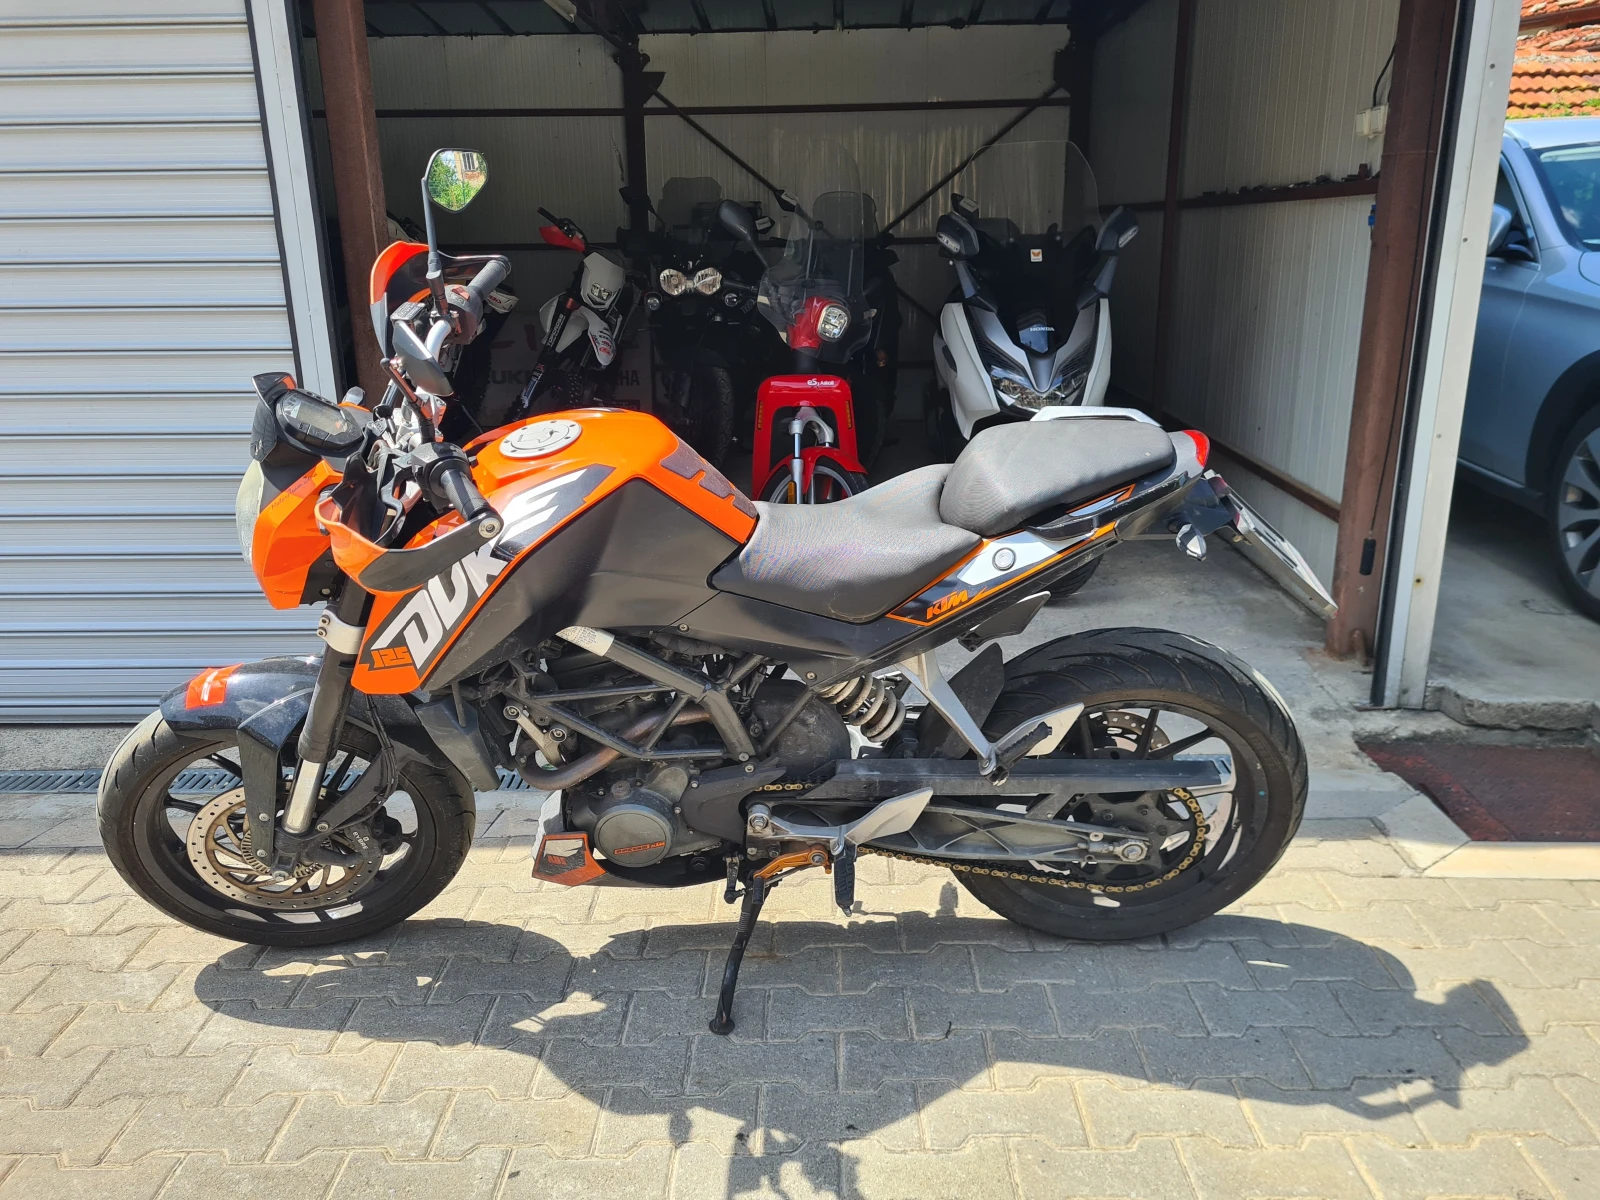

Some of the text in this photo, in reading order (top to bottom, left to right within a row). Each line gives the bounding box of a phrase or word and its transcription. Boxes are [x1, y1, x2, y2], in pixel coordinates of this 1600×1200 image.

[370, 469, 588, 669] DUKE
[926, 589, 969, 620] KTM
[370, 646, 413, 669] 125
[352, 831, 369, 851] BYBRE
